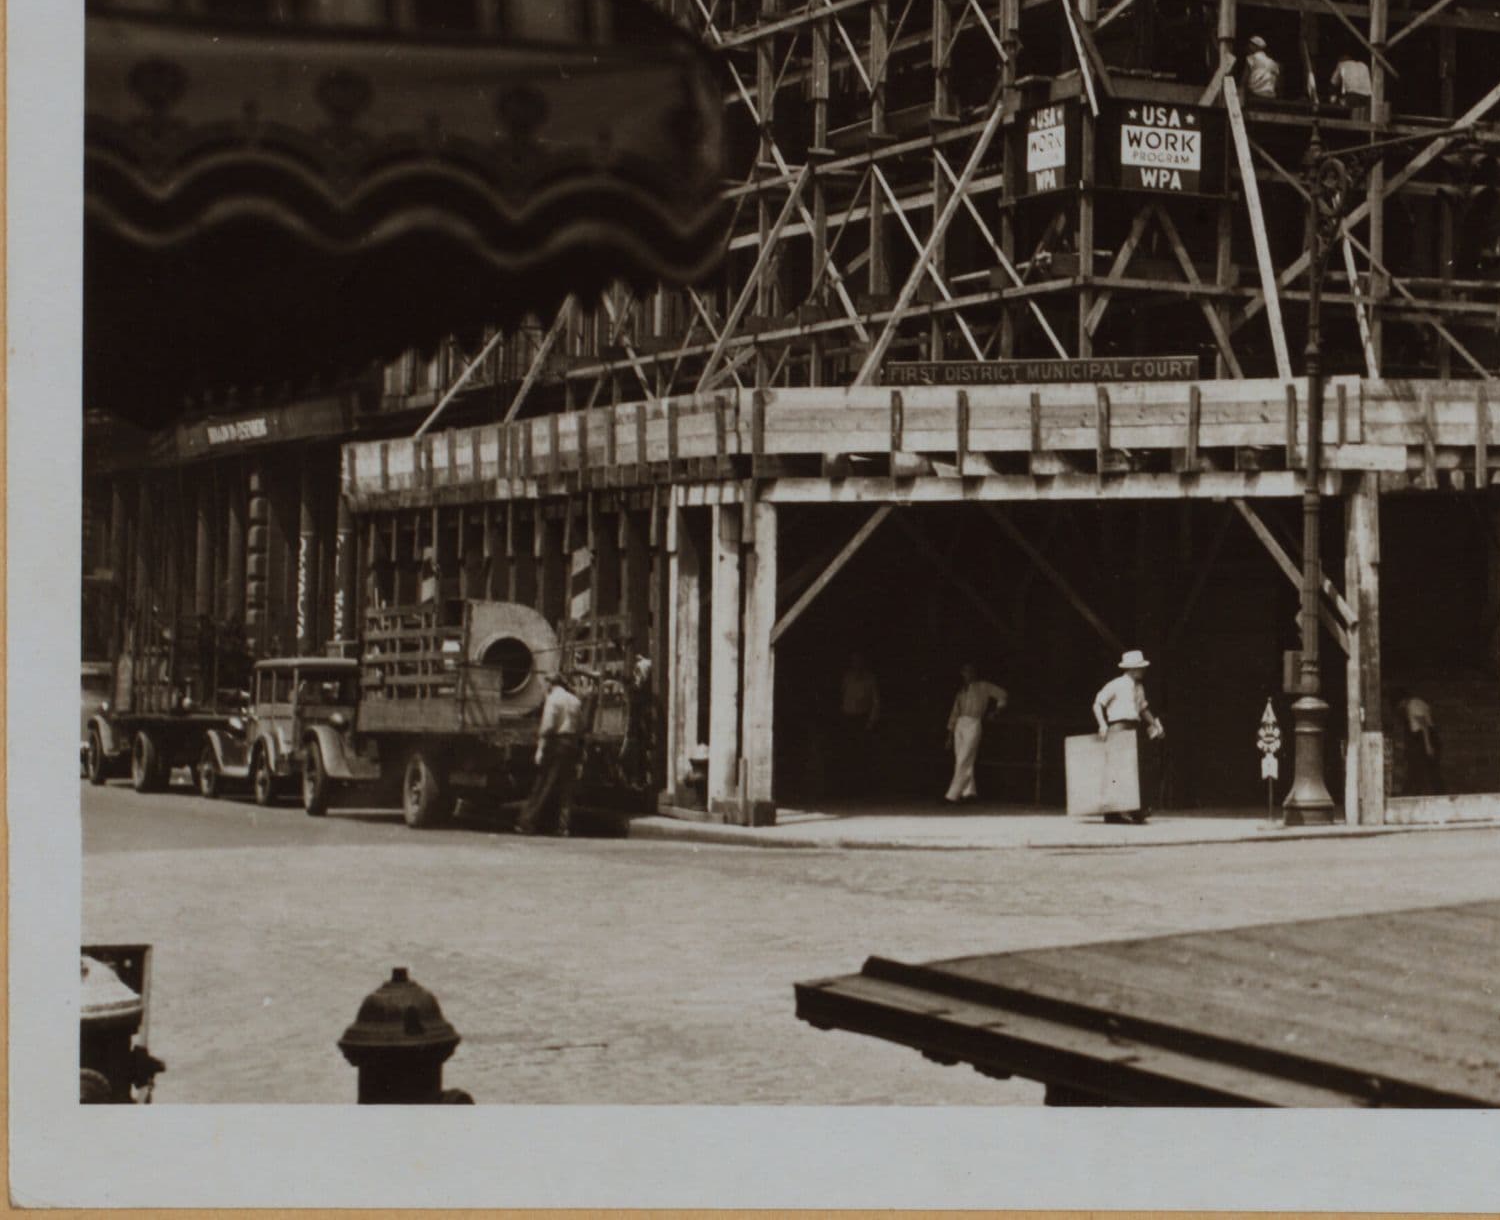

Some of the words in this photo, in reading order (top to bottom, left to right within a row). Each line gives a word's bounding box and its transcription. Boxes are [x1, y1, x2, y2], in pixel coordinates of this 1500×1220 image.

[1036, 107, 1056, 130] USA
[1142, 105, 1181, 128] USA
[1127, 130, 1196, 154] WORK
[1132, 150, 1190, 165] PROGRAM
[1140, 167, 1182, 191] WPA
[889, 365, 938, 382] FIRST
[944, 364, 1019, 381] DISTRICT
[1026, 361, 1125, 380] MUNICIPAL
[1131, 360, 1194, 378] COURT
